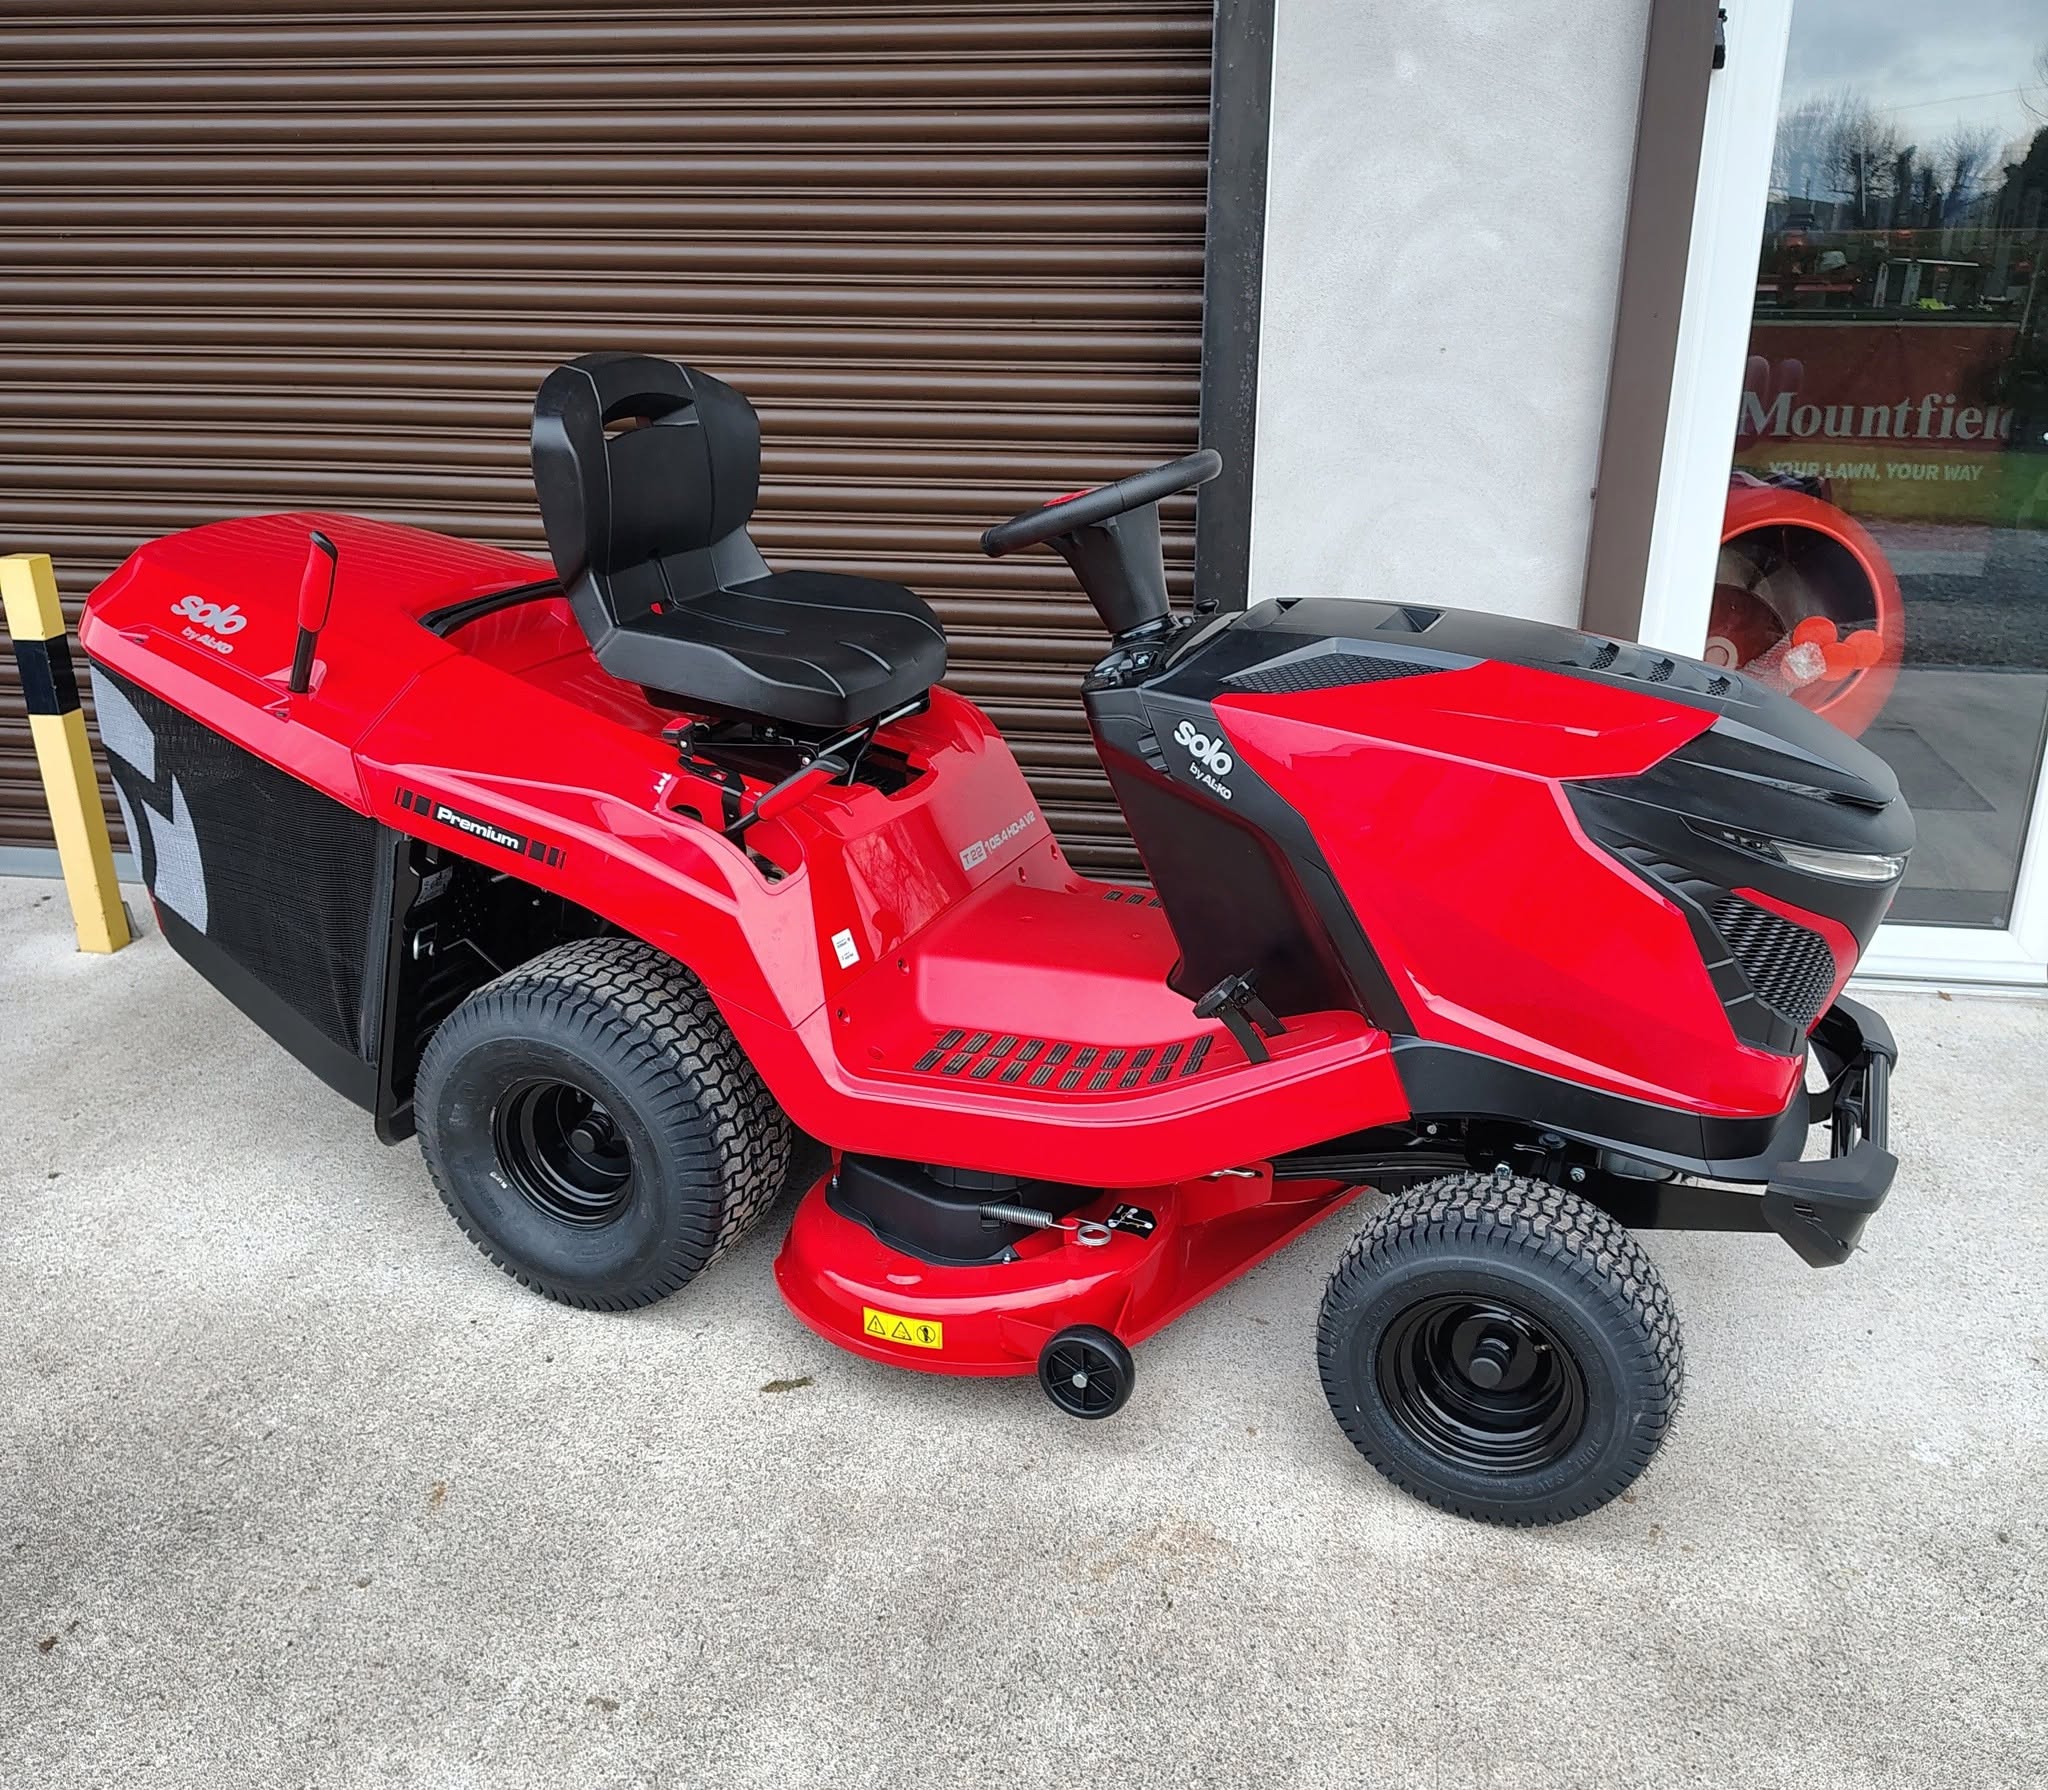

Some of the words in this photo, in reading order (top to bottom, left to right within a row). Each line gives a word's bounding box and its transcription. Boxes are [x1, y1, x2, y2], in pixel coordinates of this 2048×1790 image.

[1824, 462, 1880, 481] LAWN,
[1886, 463, 1940, 480] YOUR
[1944, 464, 1984, 481] WAY
[170, 595, 247, 635] solo
[1174, 720, 1233, 776] solo
[1189, 761, 1205, 780] by
[1201, 774, 1232, 800] AL-KO
[437, 806, 519, 849] Premium
[1023, 810, 1036, 825] V2
